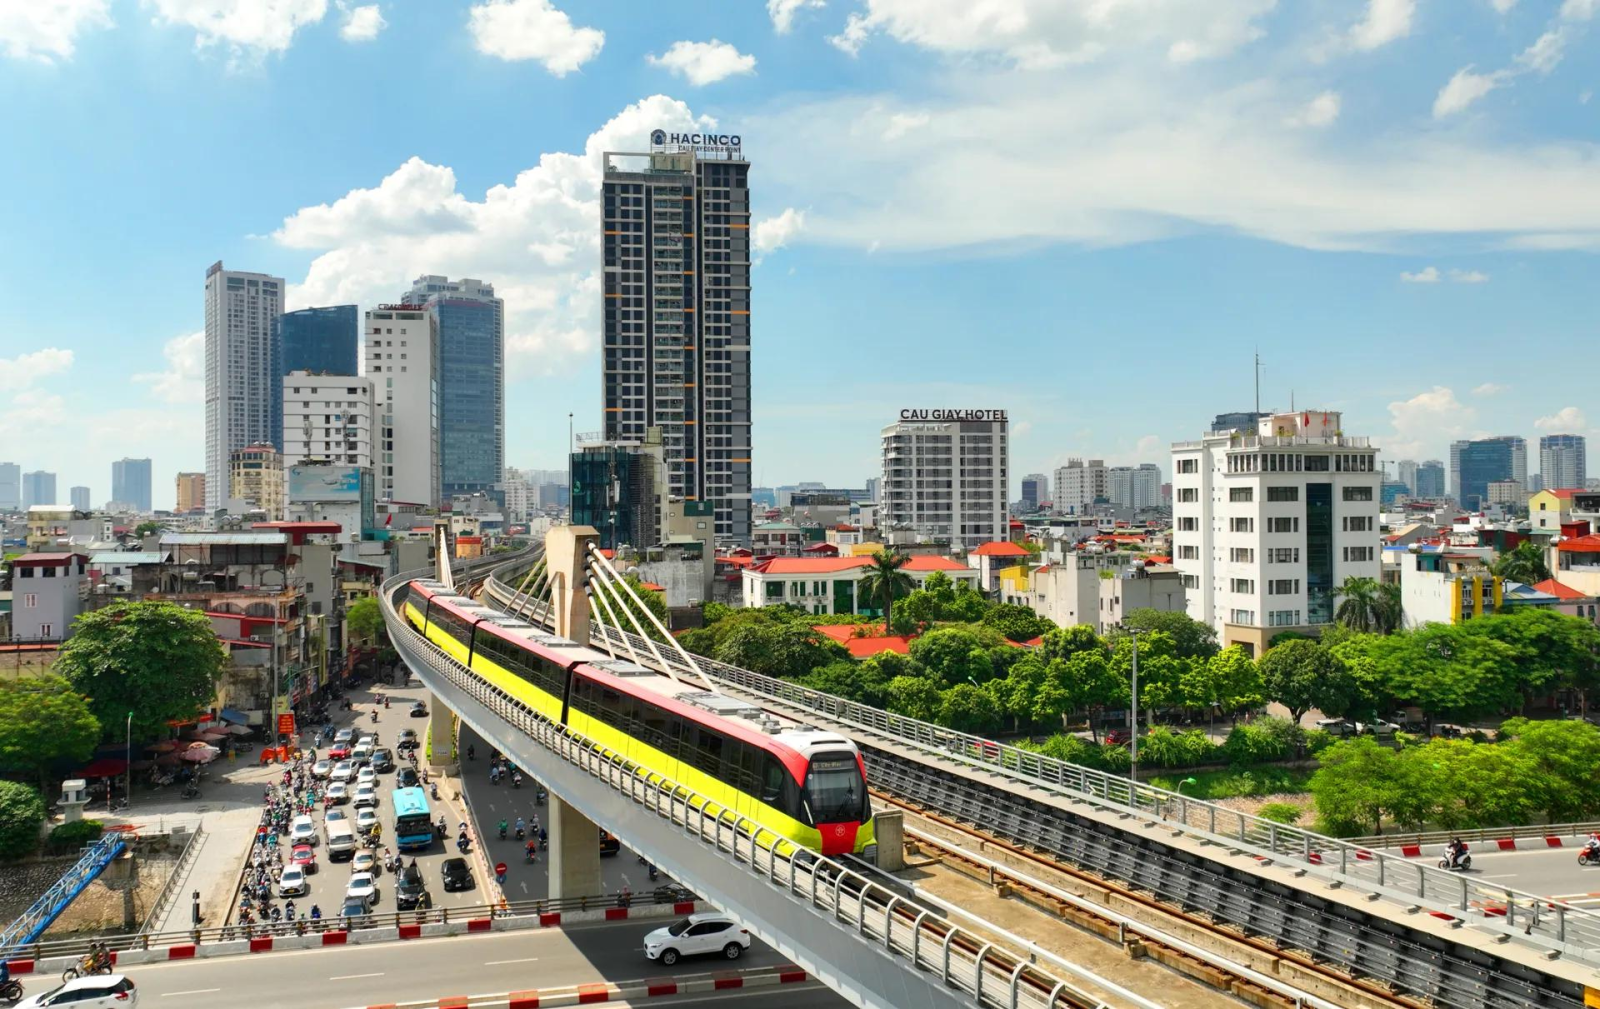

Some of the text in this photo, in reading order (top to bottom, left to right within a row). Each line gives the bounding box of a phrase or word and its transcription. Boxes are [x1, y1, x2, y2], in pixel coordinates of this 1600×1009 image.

[671, 133, 741, 145] HACINCO
[900, 409, 1008, 420] CAU GIAY HOTEL
